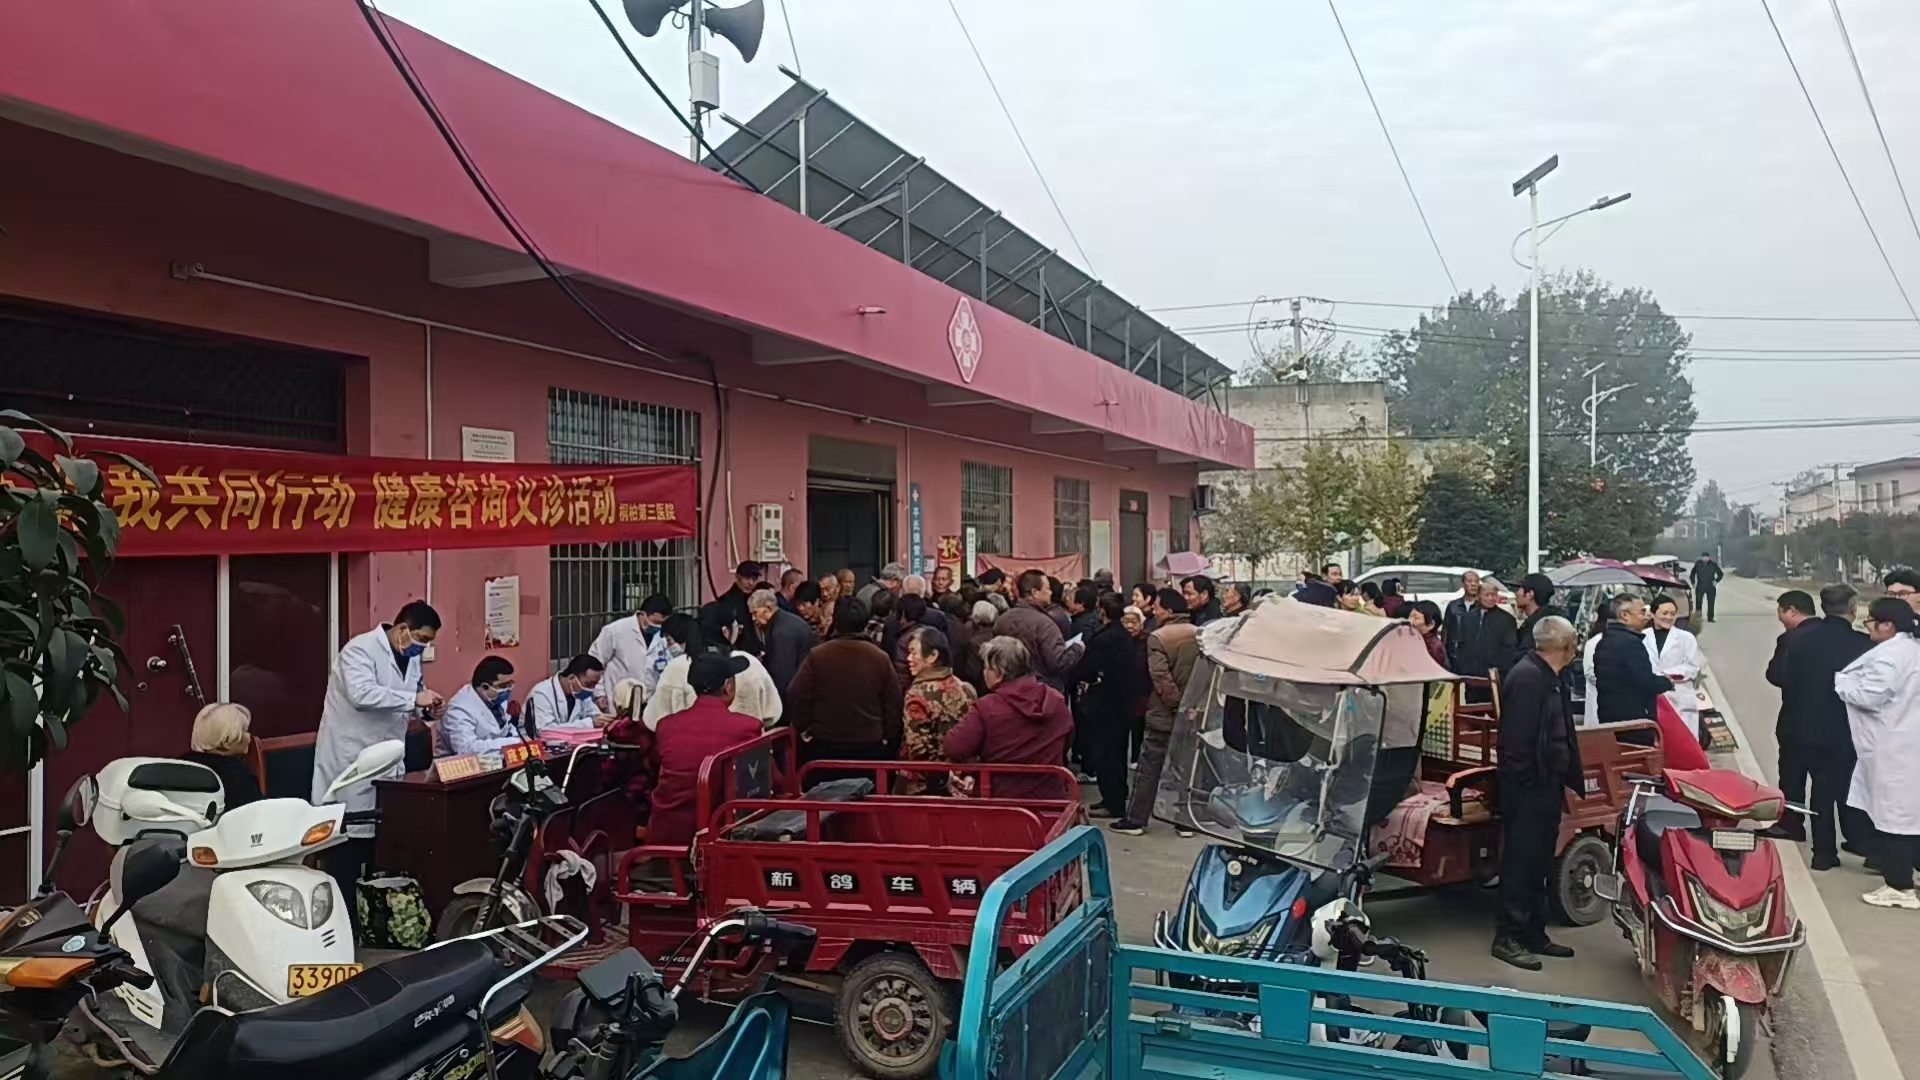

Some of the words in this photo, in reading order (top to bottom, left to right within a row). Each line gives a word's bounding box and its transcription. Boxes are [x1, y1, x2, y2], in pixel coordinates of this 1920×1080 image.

[53, 462, 356, 532] 我共同行动
[373, 471, 616, 530] 健康咨询义诊活动
[770, 871, 977, 895] 新鸽车辆
